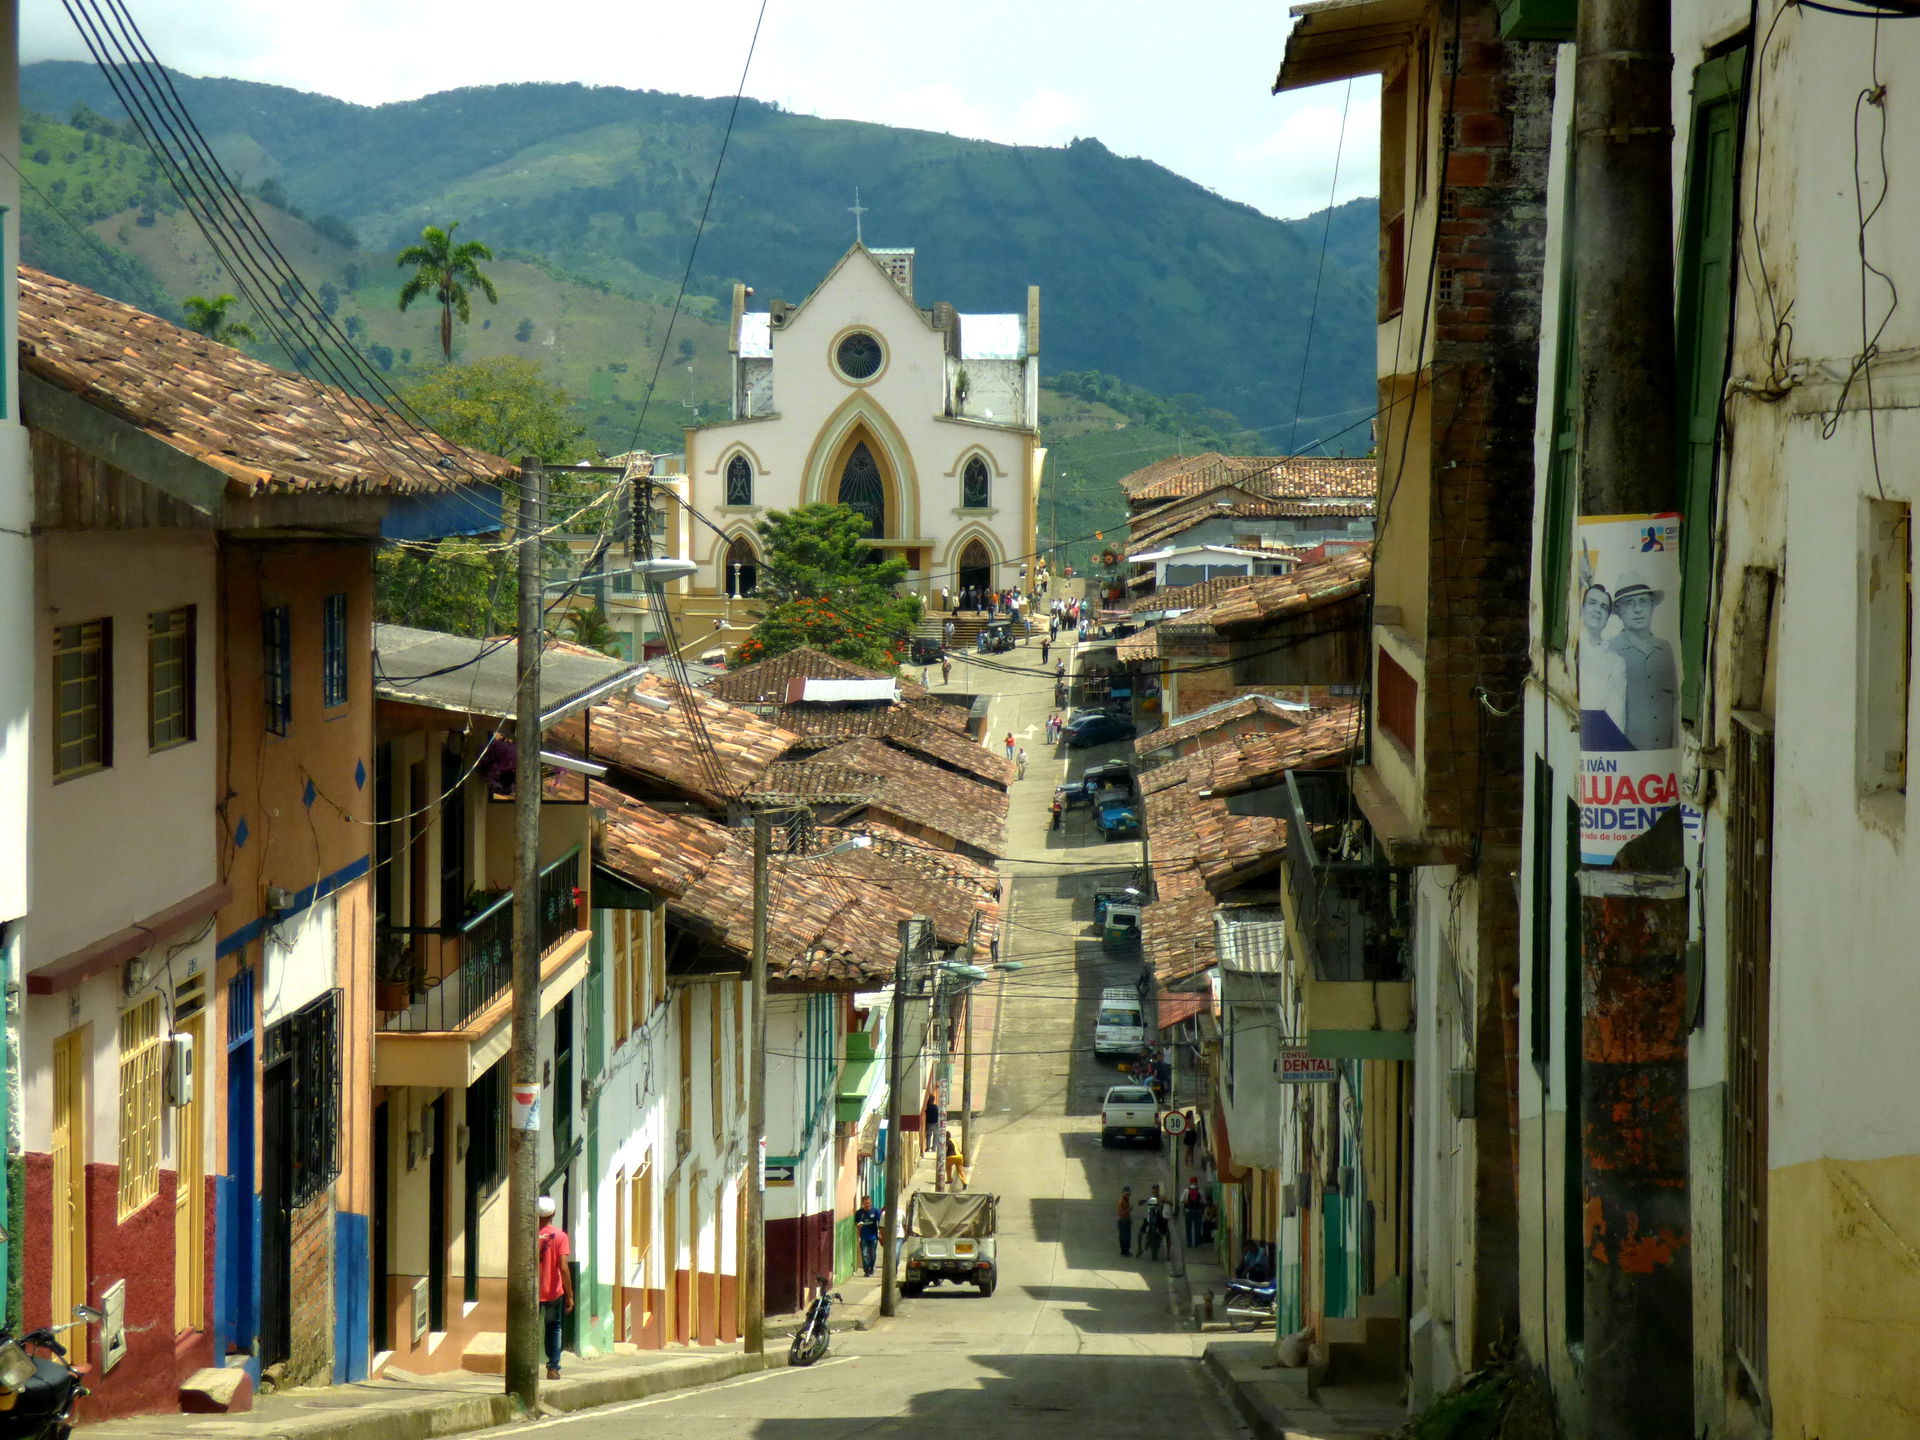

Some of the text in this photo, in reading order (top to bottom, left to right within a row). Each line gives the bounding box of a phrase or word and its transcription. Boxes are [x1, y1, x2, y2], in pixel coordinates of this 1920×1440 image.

[1587, 756, 1617, 772] IVÁN
[1580, 773, 1680, 805] LUAGA
[1599, 832, 1610, 841] de
[1613, 832, 1628, 841] los
[1284, 1059, 1334, 1071] DENTAL
[1170, 1118, 1181, 1128] 30
